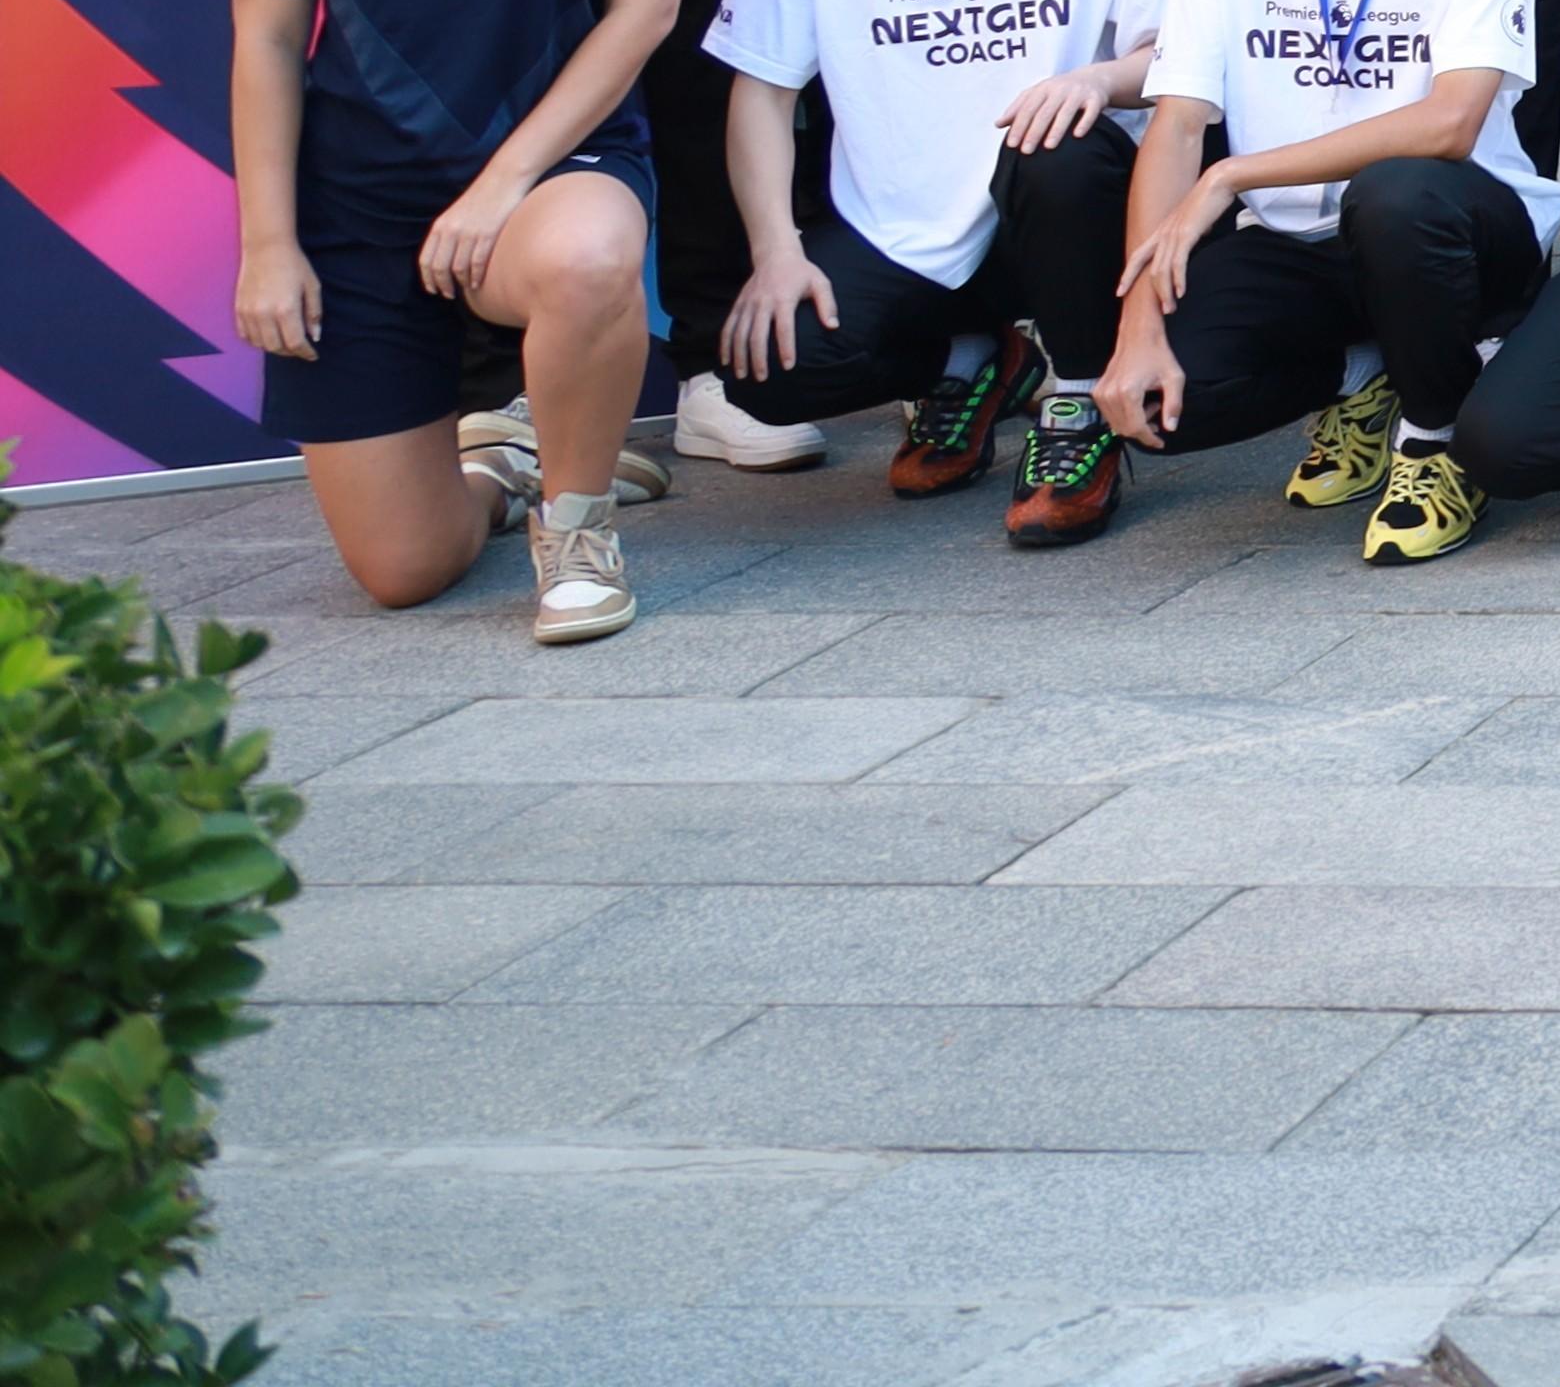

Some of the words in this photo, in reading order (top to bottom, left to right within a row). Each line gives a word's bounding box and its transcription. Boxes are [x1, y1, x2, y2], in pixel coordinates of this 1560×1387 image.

[1265, 1, 1324, 22] Premie
[927, 36, 1027, 67] COACH
[1294, 65, 1394, 90] COACH
